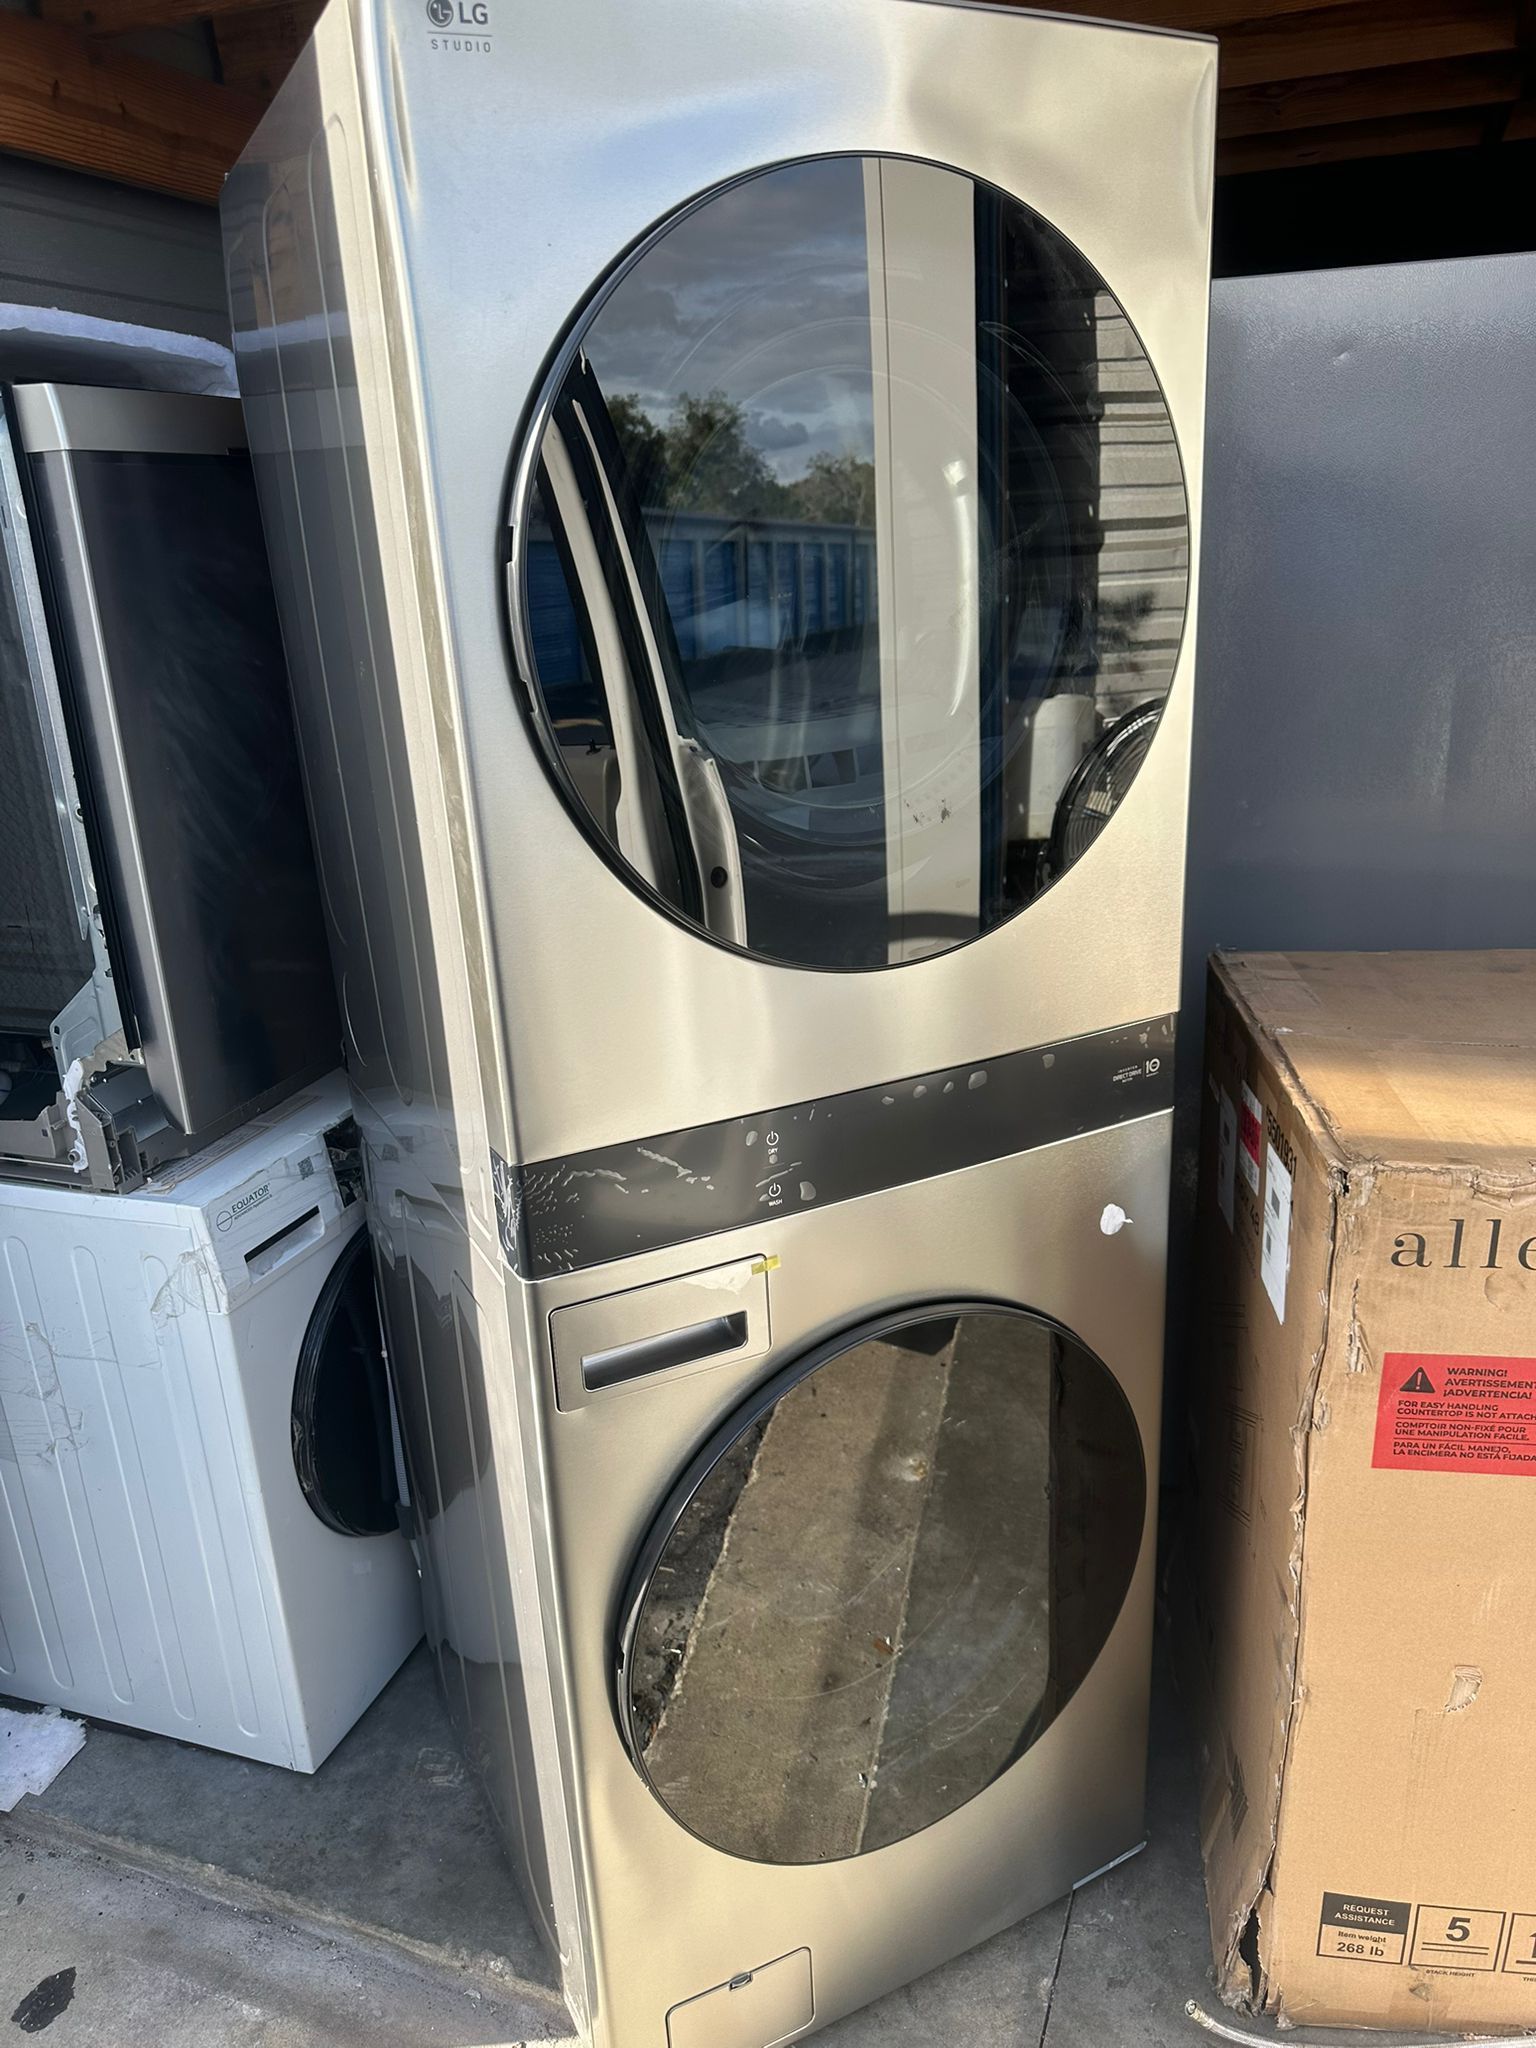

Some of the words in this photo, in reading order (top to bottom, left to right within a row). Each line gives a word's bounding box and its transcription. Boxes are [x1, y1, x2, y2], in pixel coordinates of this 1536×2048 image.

[459, 2, 488, 25] LG
[431, 39, 491, 53] STUDIO
[1146, 1058, 1160, 1073] 10
[1113, 1072, 1129, 1082] DIRECT
[1129, 1069, 1142, 1077] DRIVE
[231, 1184, 270, 1213] EQUATOR
[1447, 1367, 1508, 1378] WARNING!
[1443, 1389, 1532, 1399] ¡ADVERTENCIA!
[1397, 1408, 1463, 1416] COUNTERTOP
[1421, 1401, 1445, 1409] EASY
[1447, 1402, 1499, 1411] HANDLING
[1395, 1421, 1447, 1430] COMPTOIR
[1449, 1423, 1496, 1432] NON-FIXÉ
[1498, 1425, 1526, 1433] POUR
[1395, 1428, 1415, 1436] UNE
[1418, 1430, 1491, 1439] MANIPULATION
[1494, 1433, 1530, 1441] FACILE.
[1394, 1441, 1420, 1449] PARA
[1439, 1443, 1466, 1451] FÁCIL
[1468, 1445, 1511, 1454] MANEJO,
[1408, 1449, 1457, 1458] ENCIMERA
[1459, 1451, 1475, 1459] NO
[1477, 1451, 1501, 1460] ESTÁ
[1343, 1904, 1389, 1916] REQUEST
[1335, 1912, 1395, 1926] ASSISTANCE
[1445, 1916, 1471, 1942] 5
[1338, 1931, 1357, 1939] Item
[1357, 1934, 1386, 1943] weight
[1337, 1942, 1364, 1954] 268
[1370, 1946, 1384, 1956] lb
